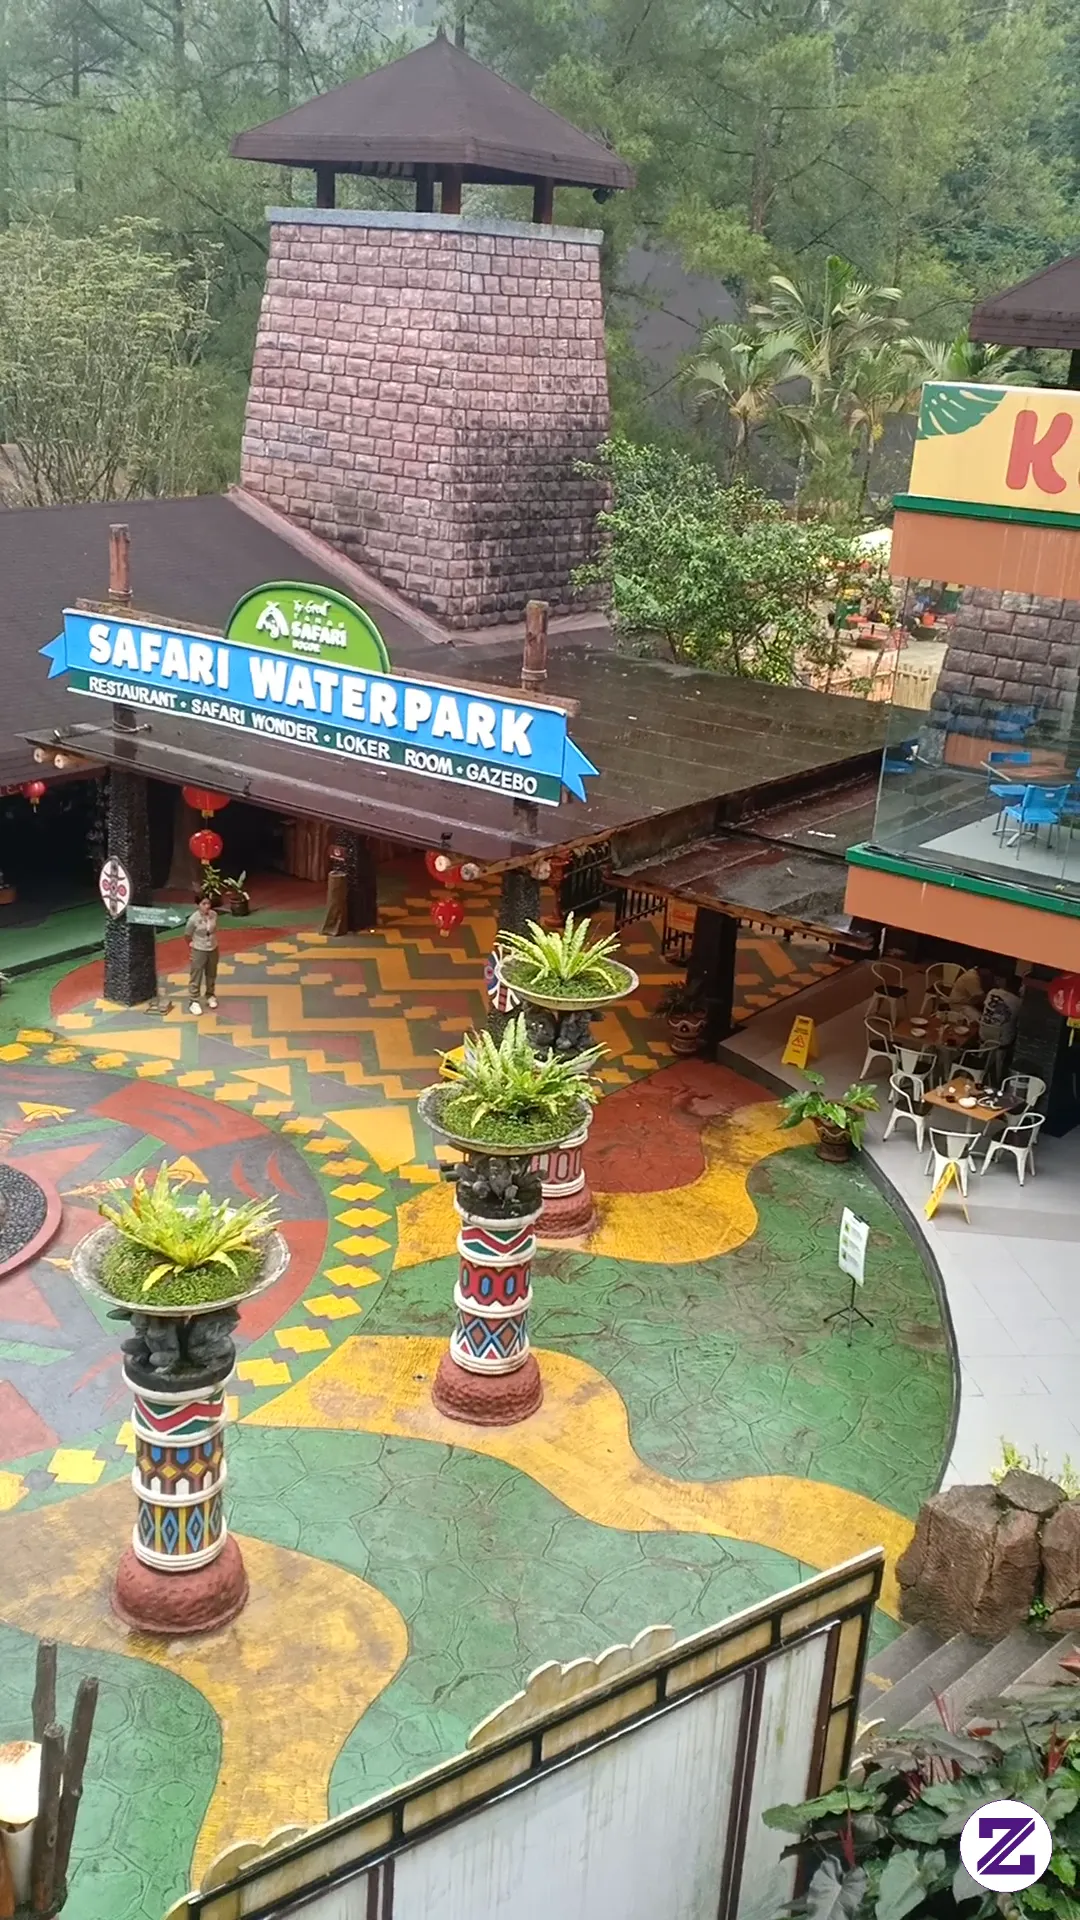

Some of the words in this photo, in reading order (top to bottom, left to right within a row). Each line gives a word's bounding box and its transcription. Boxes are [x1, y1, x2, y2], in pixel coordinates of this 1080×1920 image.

[1006, 410, 1080, 494] K
[291, 621, 347, 647] SAFARI
[88, 623, 230, 690] SAFARI
[249, 656, 534, 757] WATERPARK
[89, 676, 178, 708] RESTAURANT
[191, 699, 246, 725] SAFARI
[252, 712, 319, 743] WONDER
[336, 732, 391, 760] LOKER
[404, 748, 453, 775] ROOM
[466, 763, 538, 795] GAZEBO
